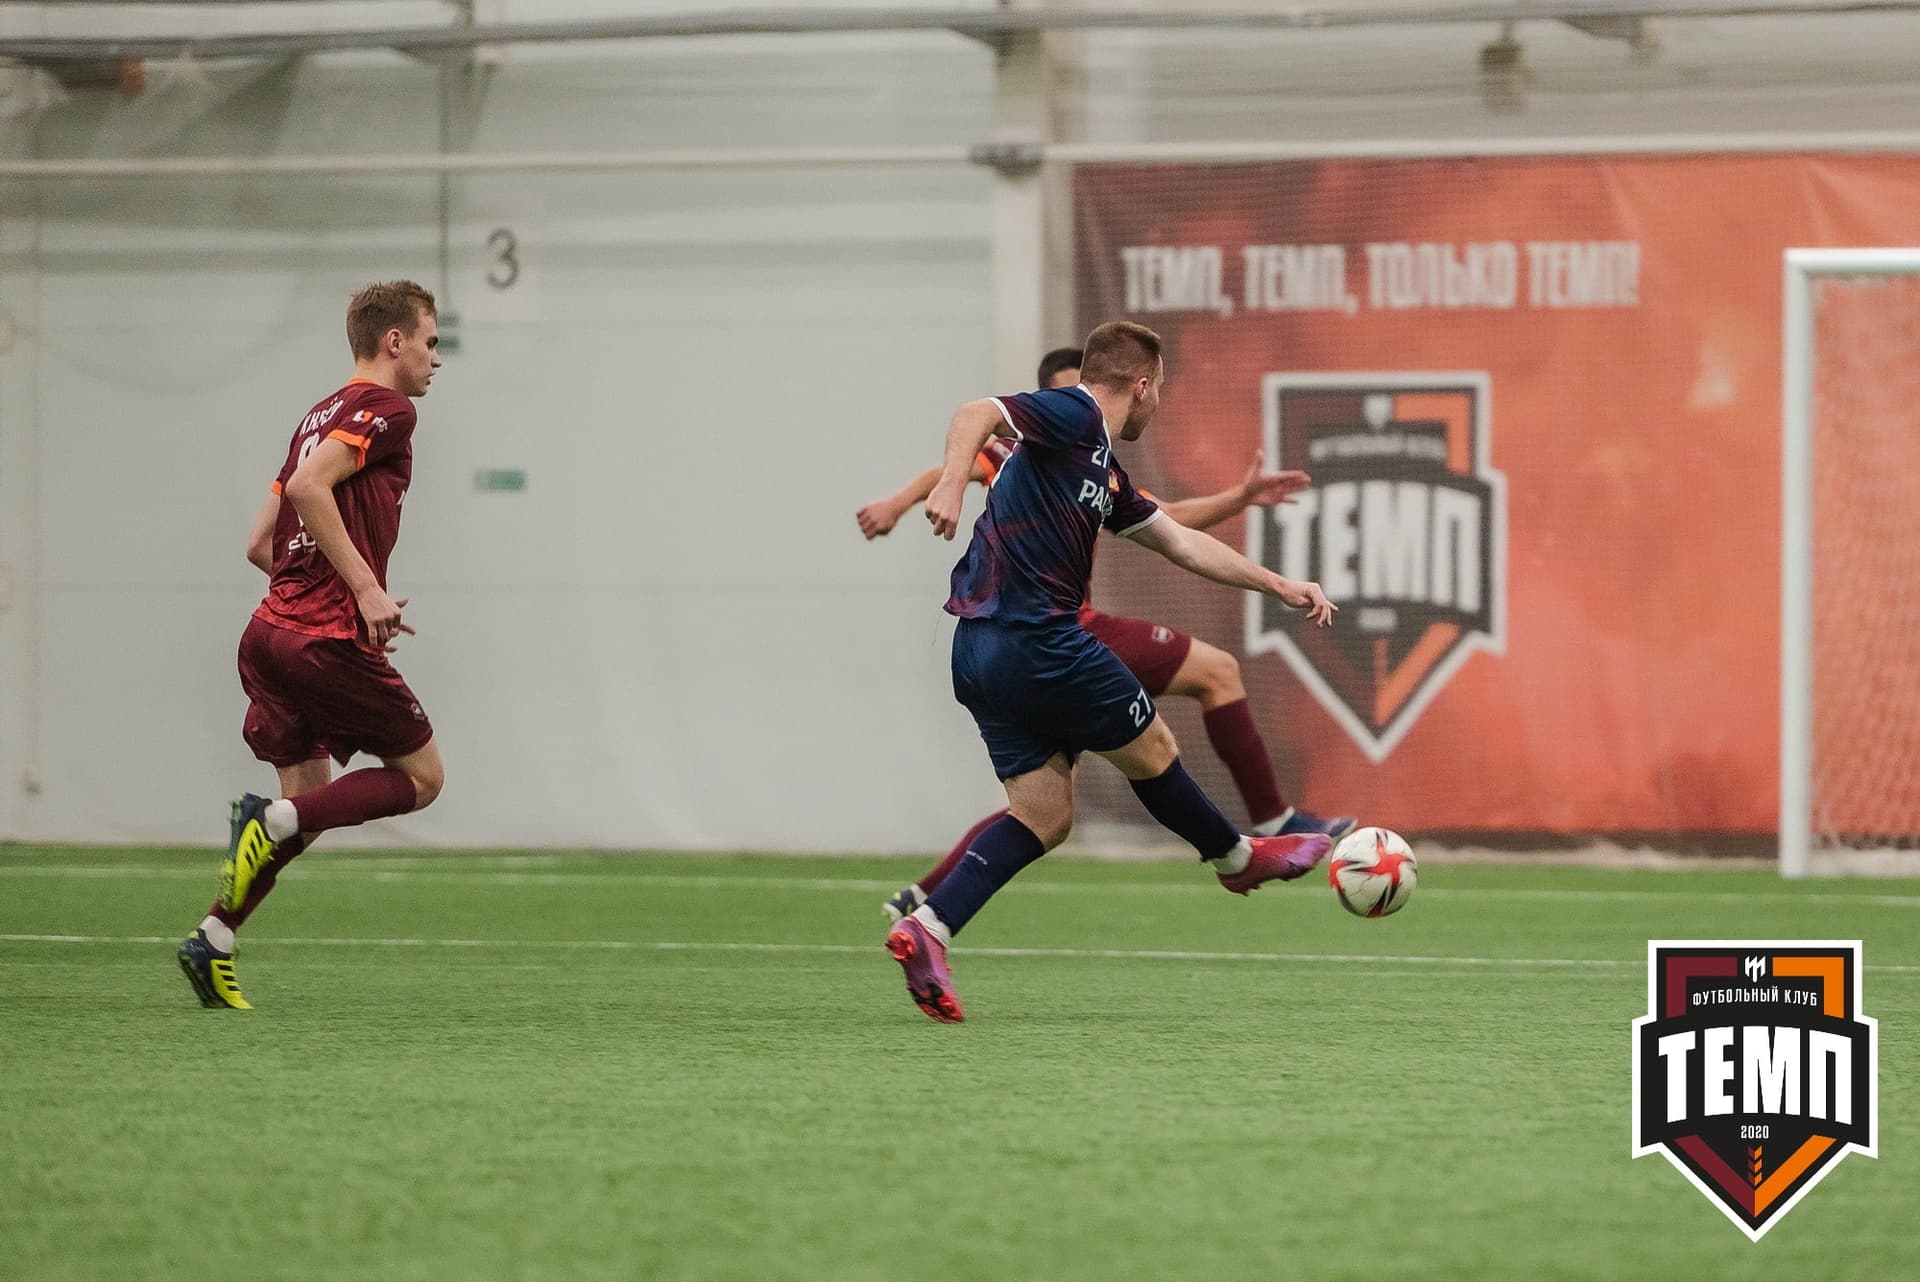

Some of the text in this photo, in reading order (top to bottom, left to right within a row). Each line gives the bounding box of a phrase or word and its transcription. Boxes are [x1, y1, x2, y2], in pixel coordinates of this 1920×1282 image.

[486, 228, 520, 290] 3
[1122, 245, 1232, 318] ТЕМП,
[1241, 244, 1358, 318] ТЕМП,
[1365, 242, 1516, 310] ТОЛЬКО
[1273, 479, 1480, 614] ТЕМП
[1129, 687, 1151, 728] 27
